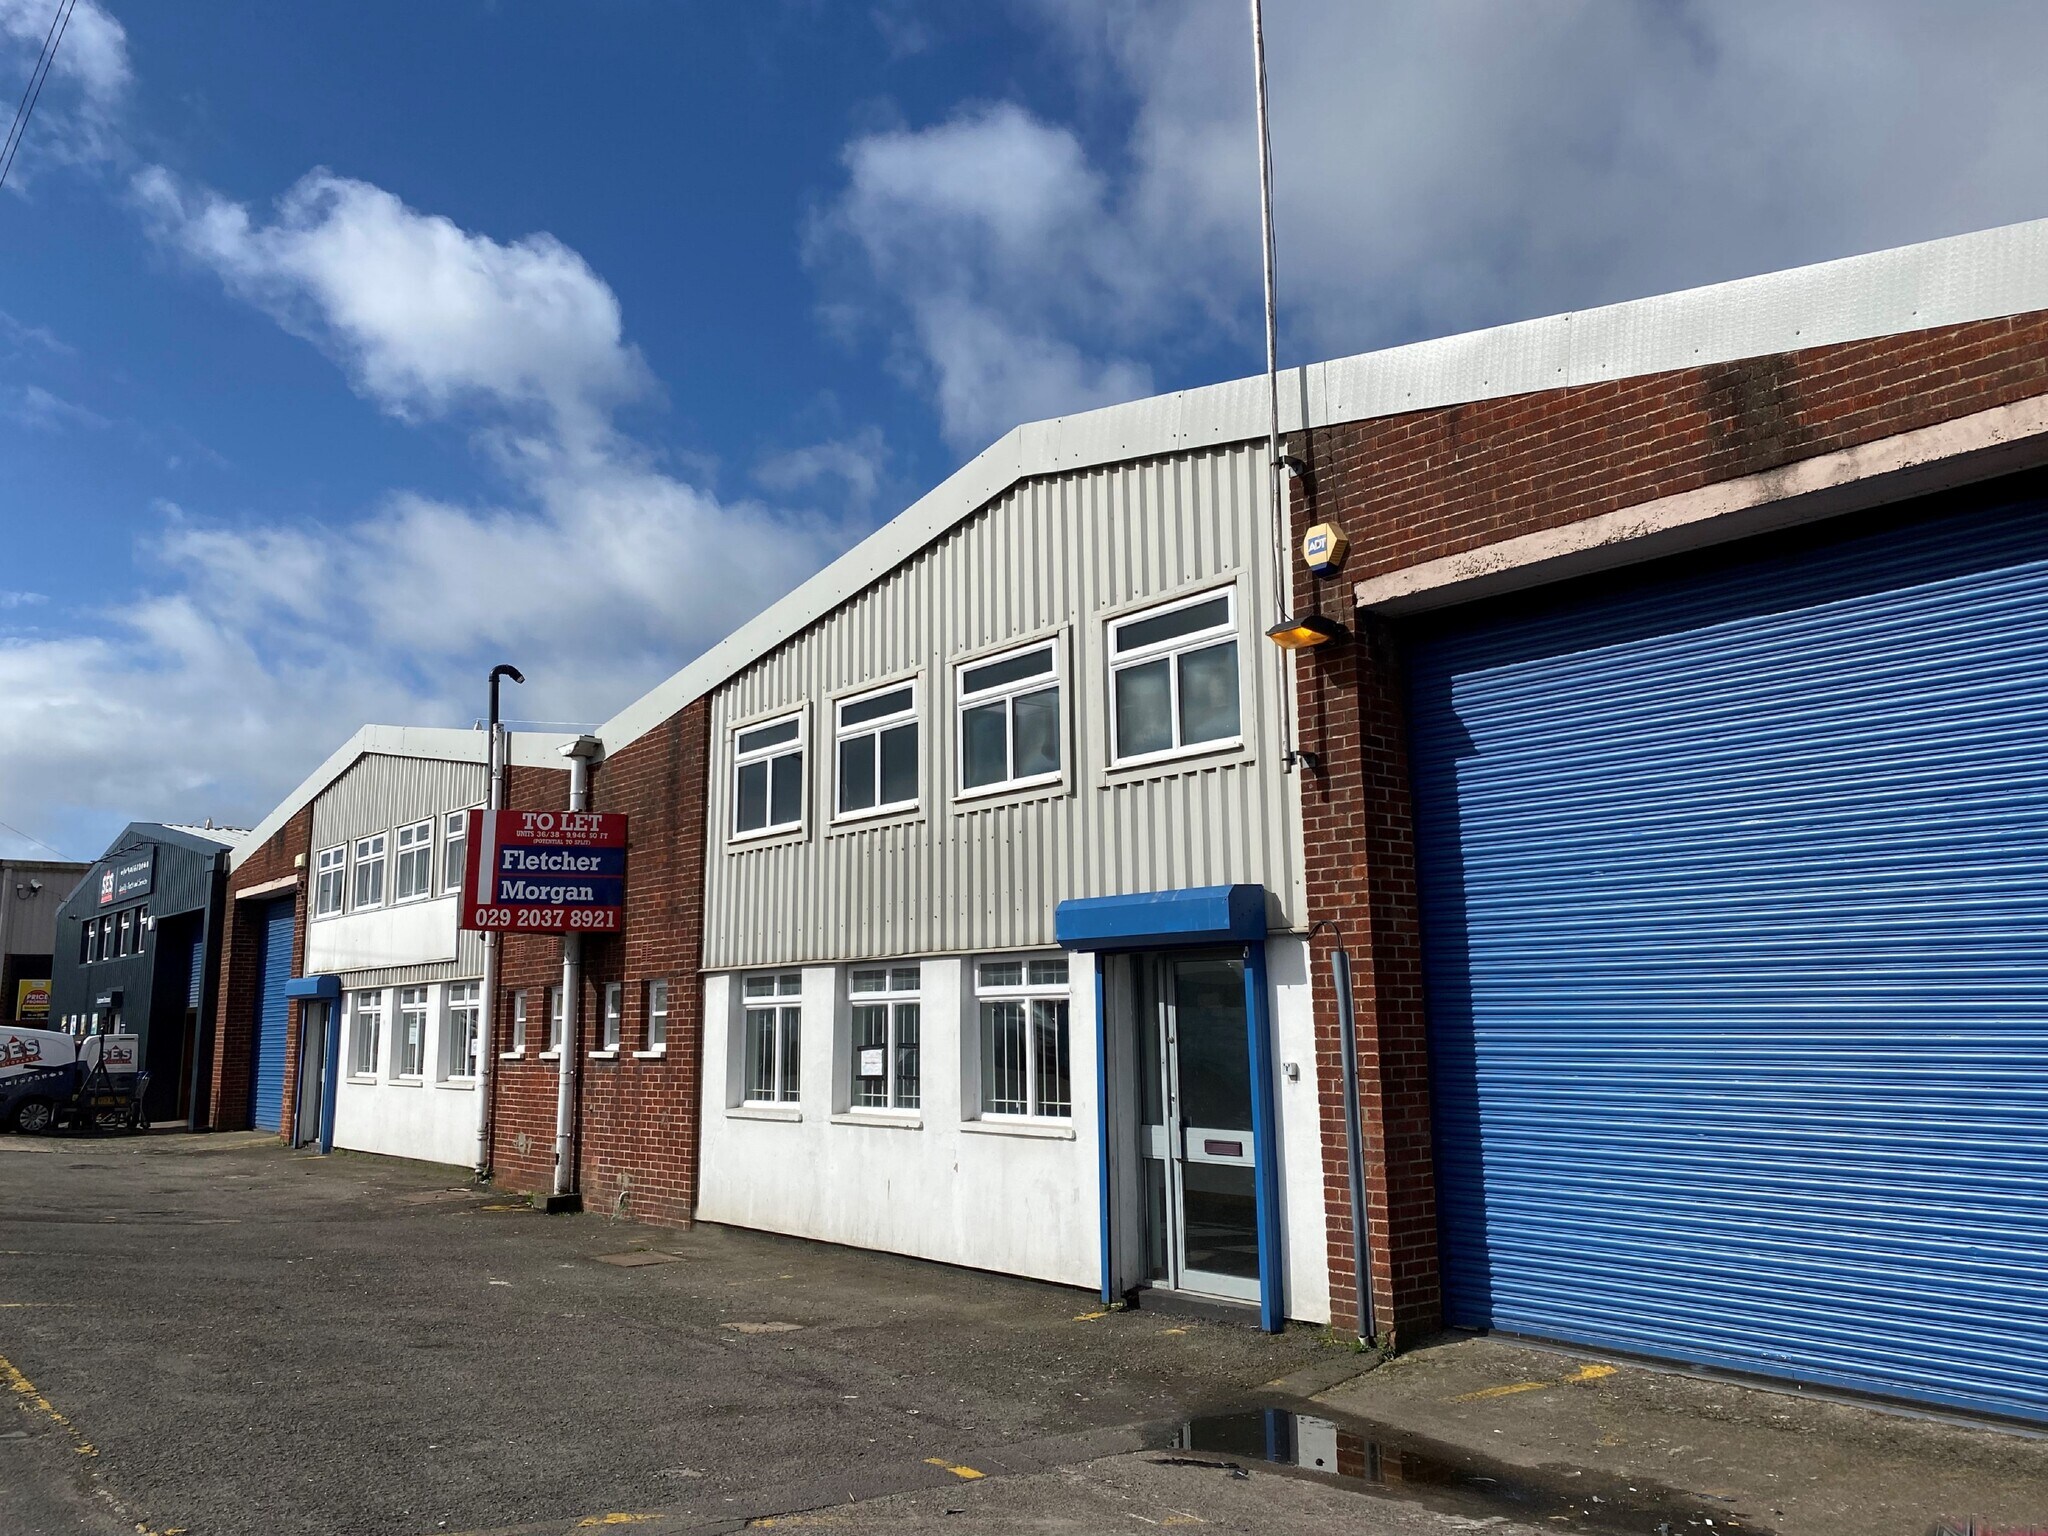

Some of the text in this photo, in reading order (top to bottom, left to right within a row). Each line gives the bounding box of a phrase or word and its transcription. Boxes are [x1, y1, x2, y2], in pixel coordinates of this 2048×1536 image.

[1308, 537, 1327, 551] ADT
[522, 812, 602, 831] TO LET
[502, 850, 601, 871] Fletcher
[500, 880, 594, 904] Morgan
[475, 909, 614, 927] 029 2037 8921
